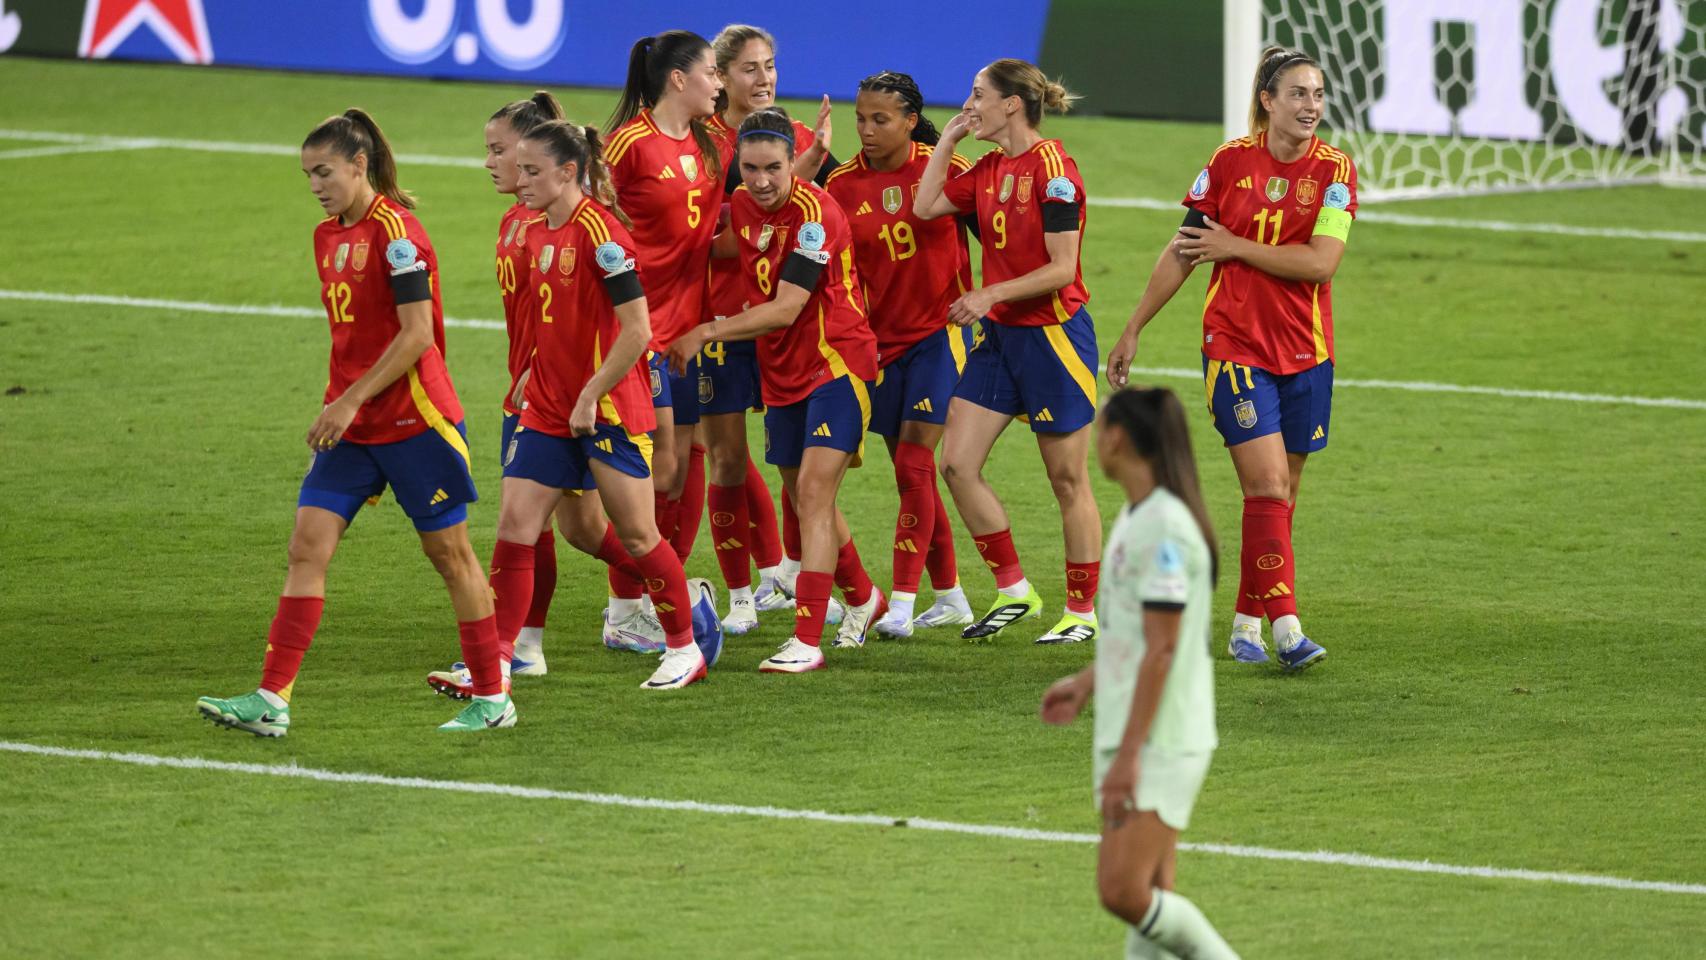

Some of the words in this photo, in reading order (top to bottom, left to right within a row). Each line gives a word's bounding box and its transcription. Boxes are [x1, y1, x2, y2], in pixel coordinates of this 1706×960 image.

[687, 190, 702, 229] 5
[1253, 208, 1284, 245] 11
[878, 221, 917, 262] 19
[992, 210, 1007, 249] 9
[496, 256, 516, 296] 20
[756, 257, 772, 296] 8
[328, 282, 354, 322] 12
[539, 283, 553, 323] 2
